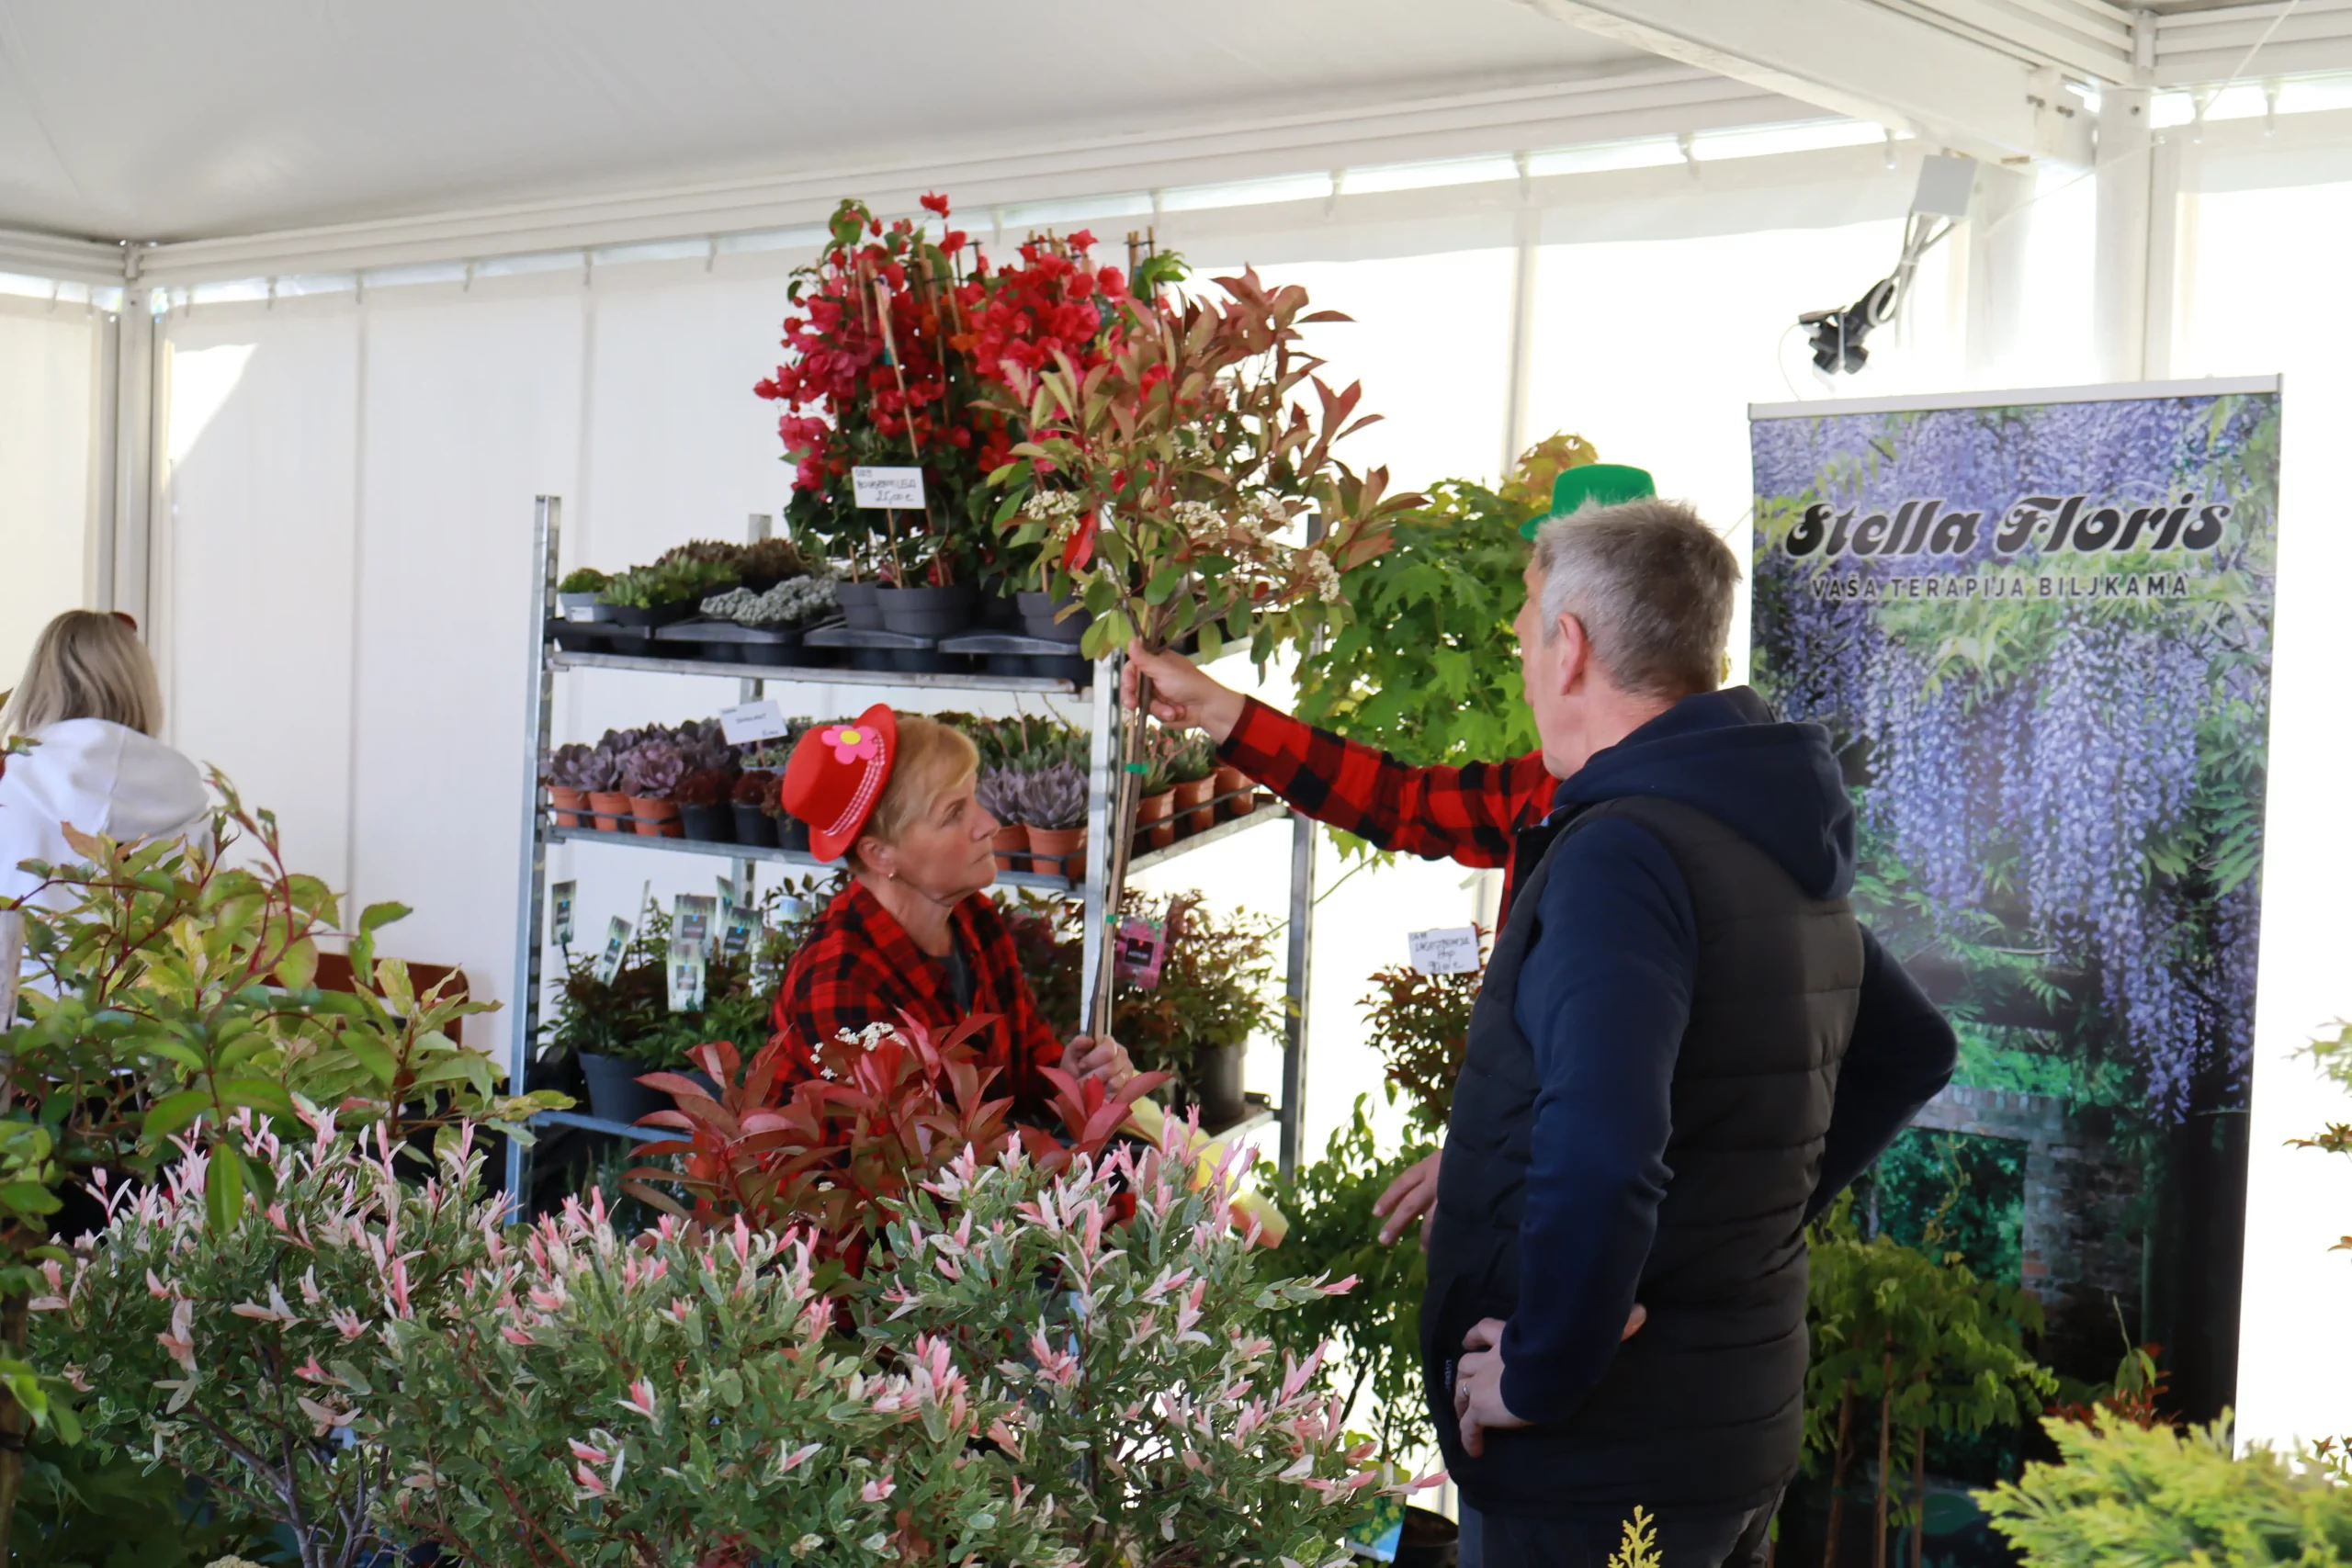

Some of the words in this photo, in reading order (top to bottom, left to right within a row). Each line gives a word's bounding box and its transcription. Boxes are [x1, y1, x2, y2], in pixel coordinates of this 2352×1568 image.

[1785, 499, 1984, 557] Stella
[1996, 491, 2232, 554] Floris
[1812, 573, 1877, 598] VAŠA
[1892, 577, 2023, 598] TERAPIJA
[2039, 574, 2188, 597] BILJKAMA
